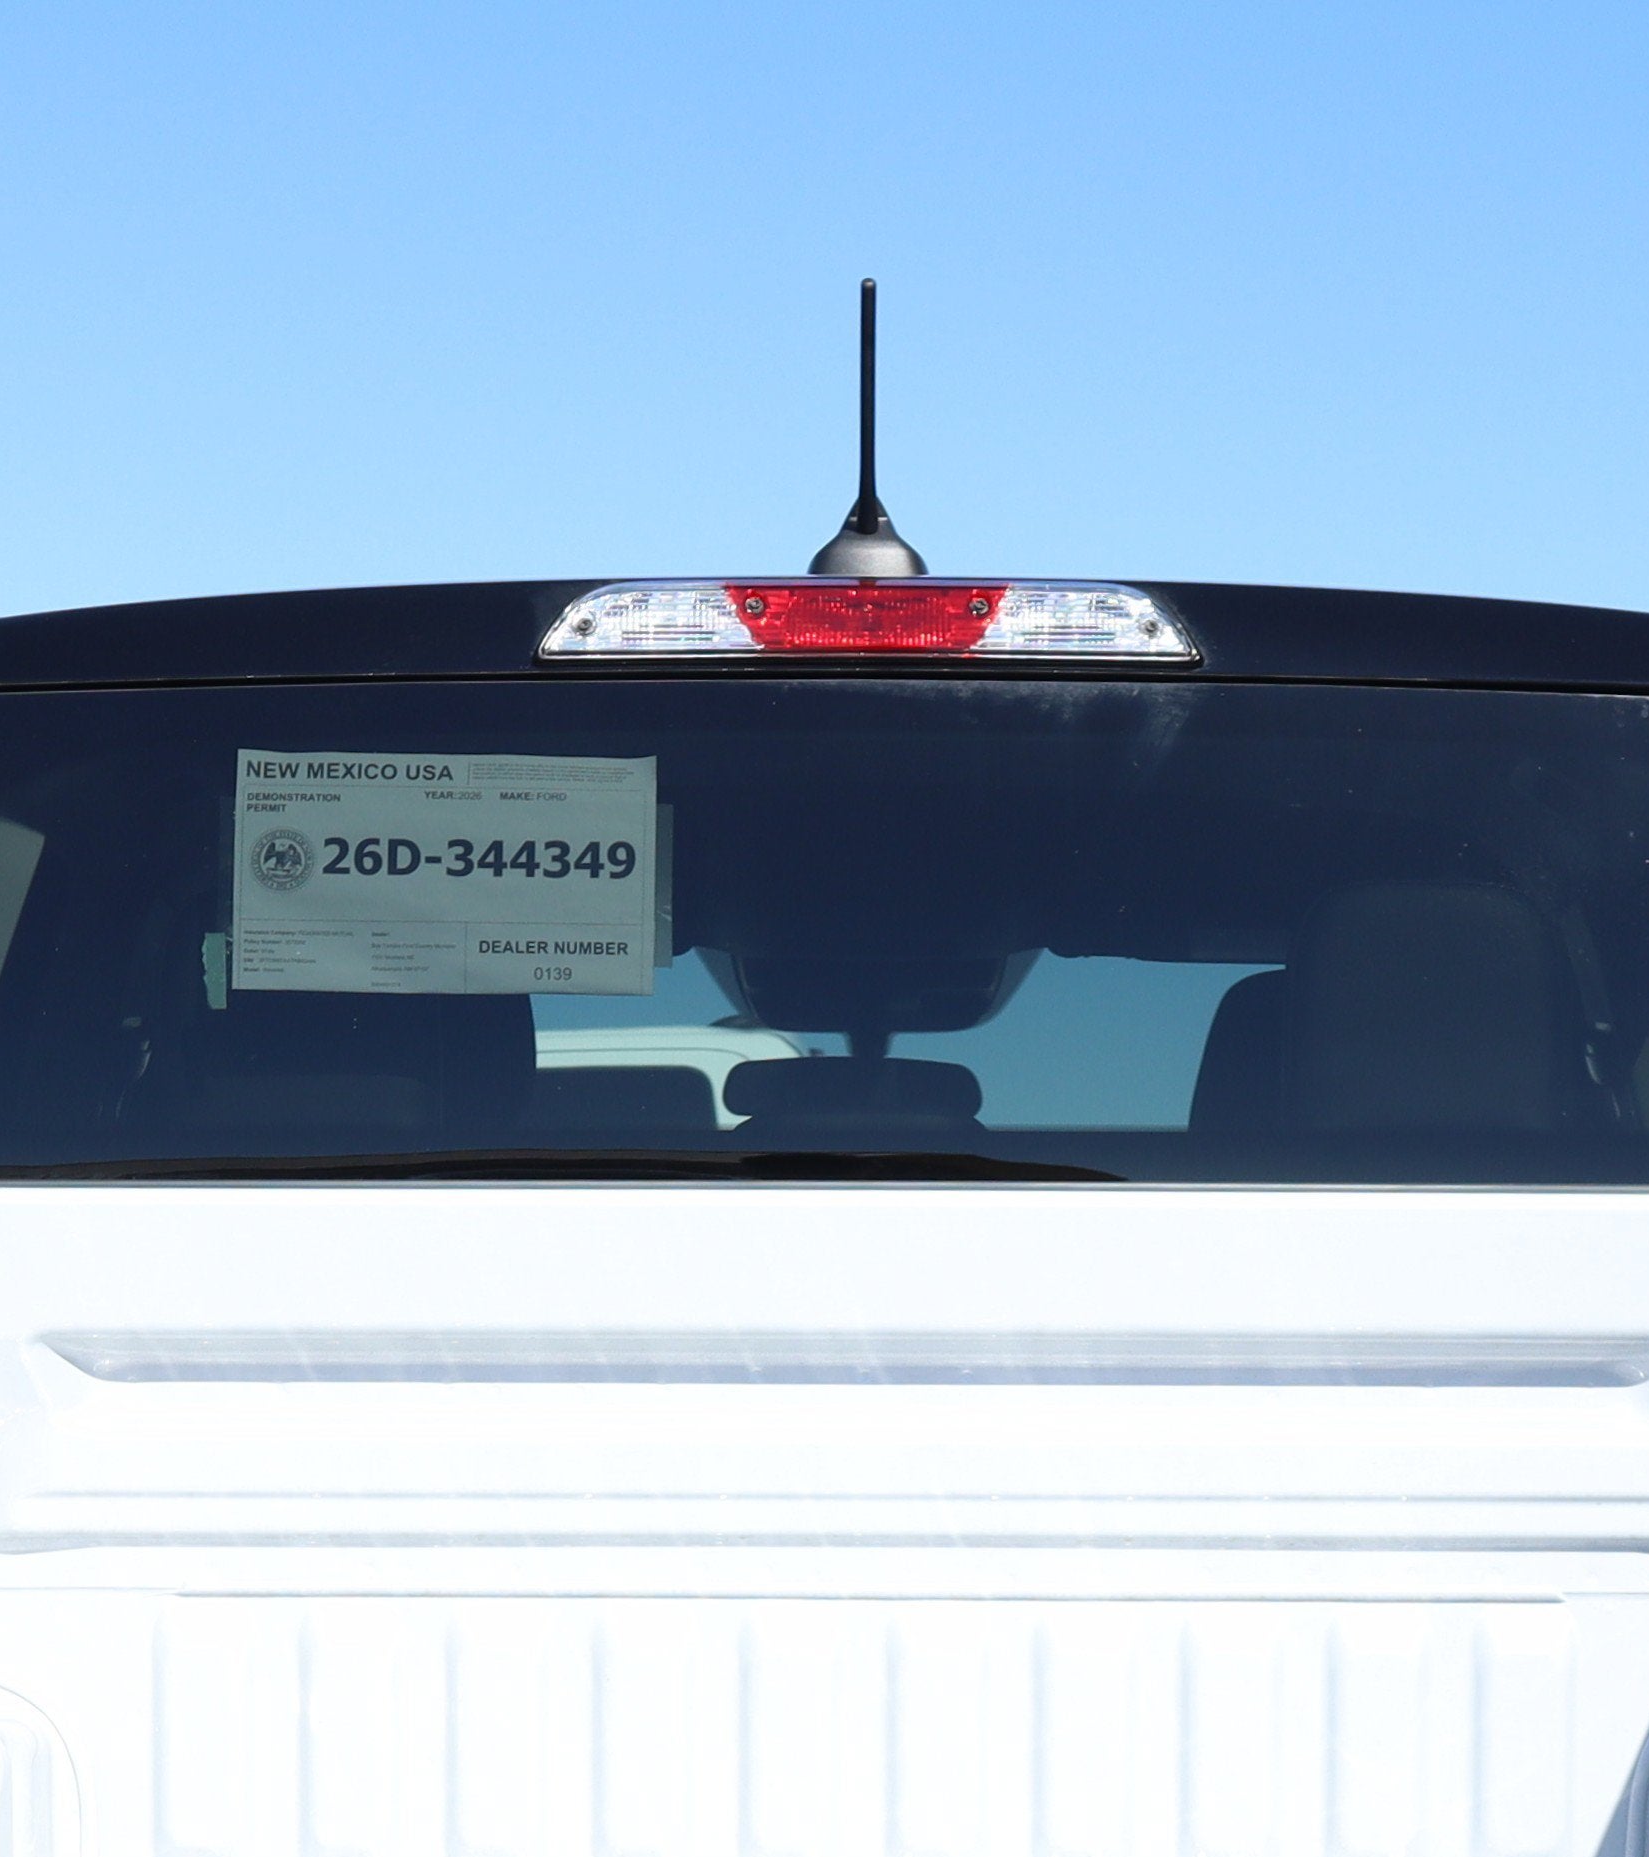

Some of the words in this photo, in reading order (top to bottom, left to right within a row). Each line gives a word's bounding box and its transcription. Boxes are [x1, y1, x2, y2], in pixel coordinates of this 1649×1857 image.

[246, 760, 300, 779] NEW
[306, 762, 398, 780] MEXICO
[405, 764, 454, 781] USA
[247, 792, 341, 802] DEMONSTRATION
[536, 792, 568, 801] FORD
[246, 803, 287, 812] PERMIT
[322, 837, 636, 880] 26D-344349
[478, 940, 549, 954] DEALER
[554, 941, 629, 955] NUMBER
[533, 966, 573, 981] 0139
